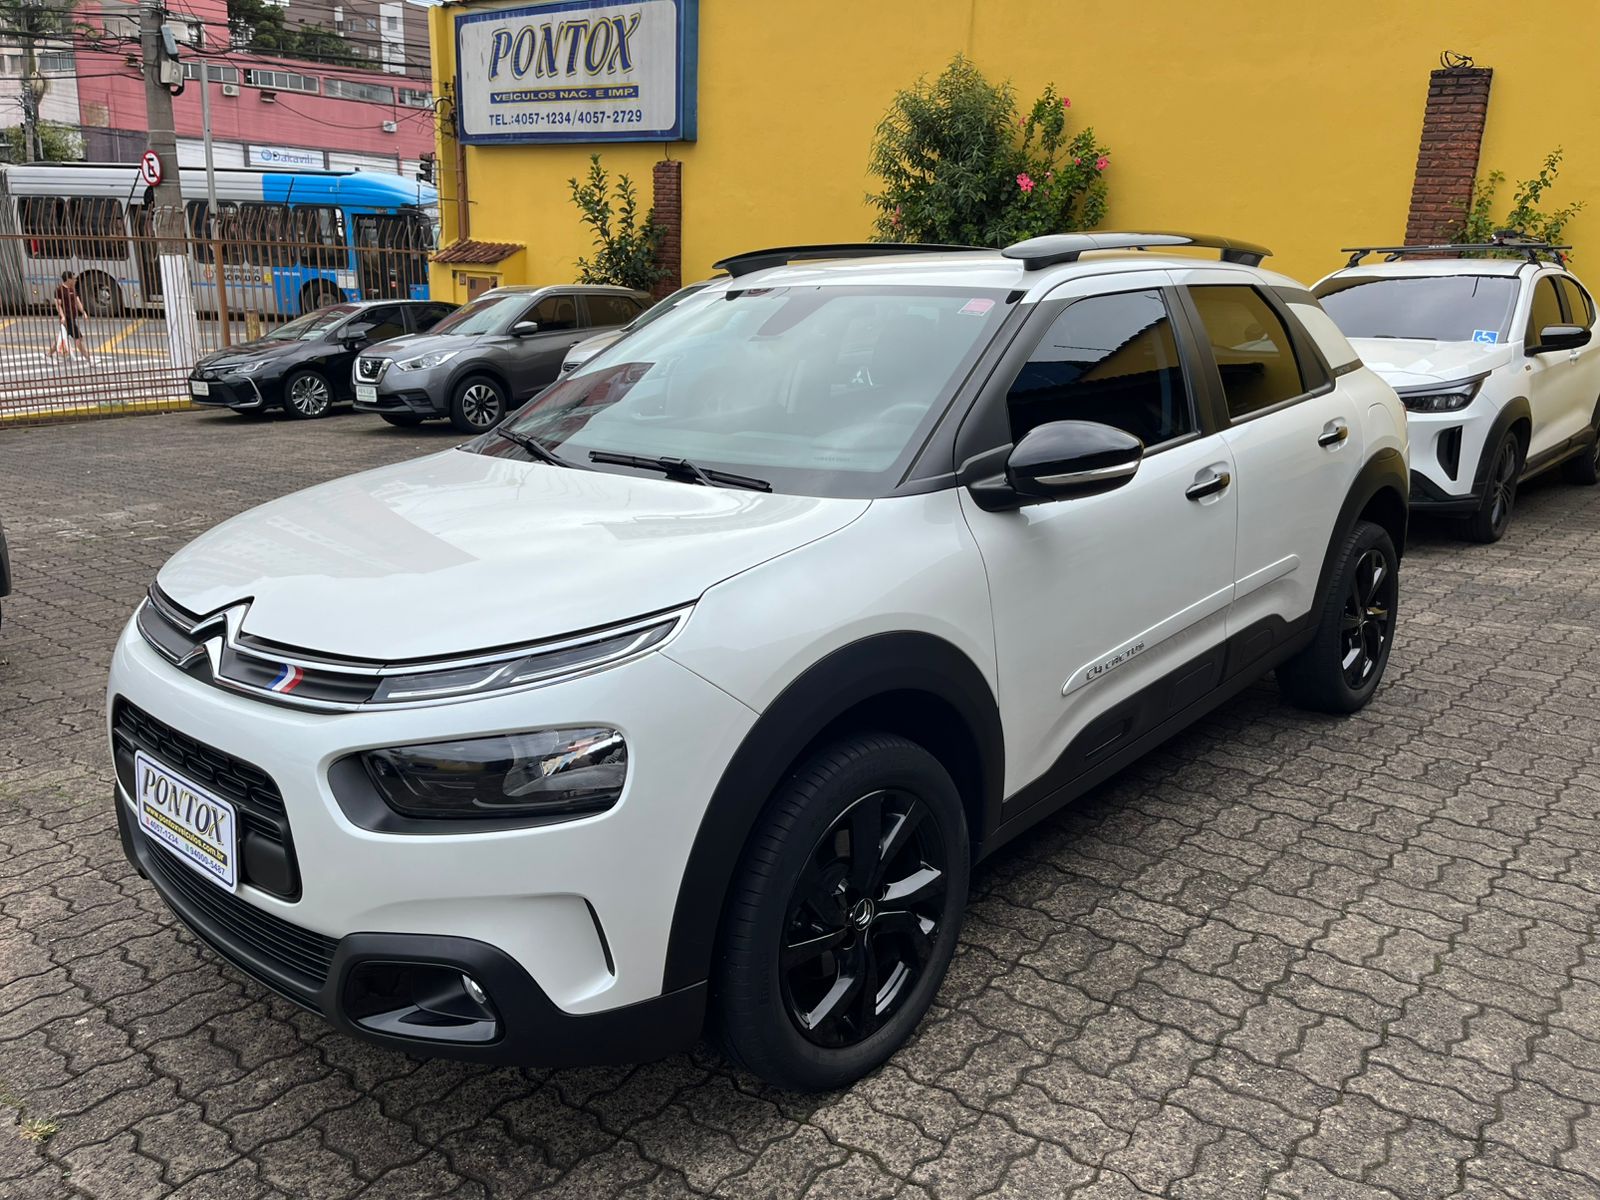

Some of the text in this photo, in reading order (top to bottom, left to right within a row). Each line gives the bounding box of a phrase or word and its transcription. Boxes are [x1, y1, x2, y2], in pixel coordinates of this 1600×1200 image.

[488, 13, 641, 82] PONTOX
[560, 89, 592, 100] NAC.
[595, 89, 605, 98] E
[608, 87, 636, 98] IMP.
[1105, 641, 1145, 669] CACTUS
[143, 766, 226, 846] PONTOX
